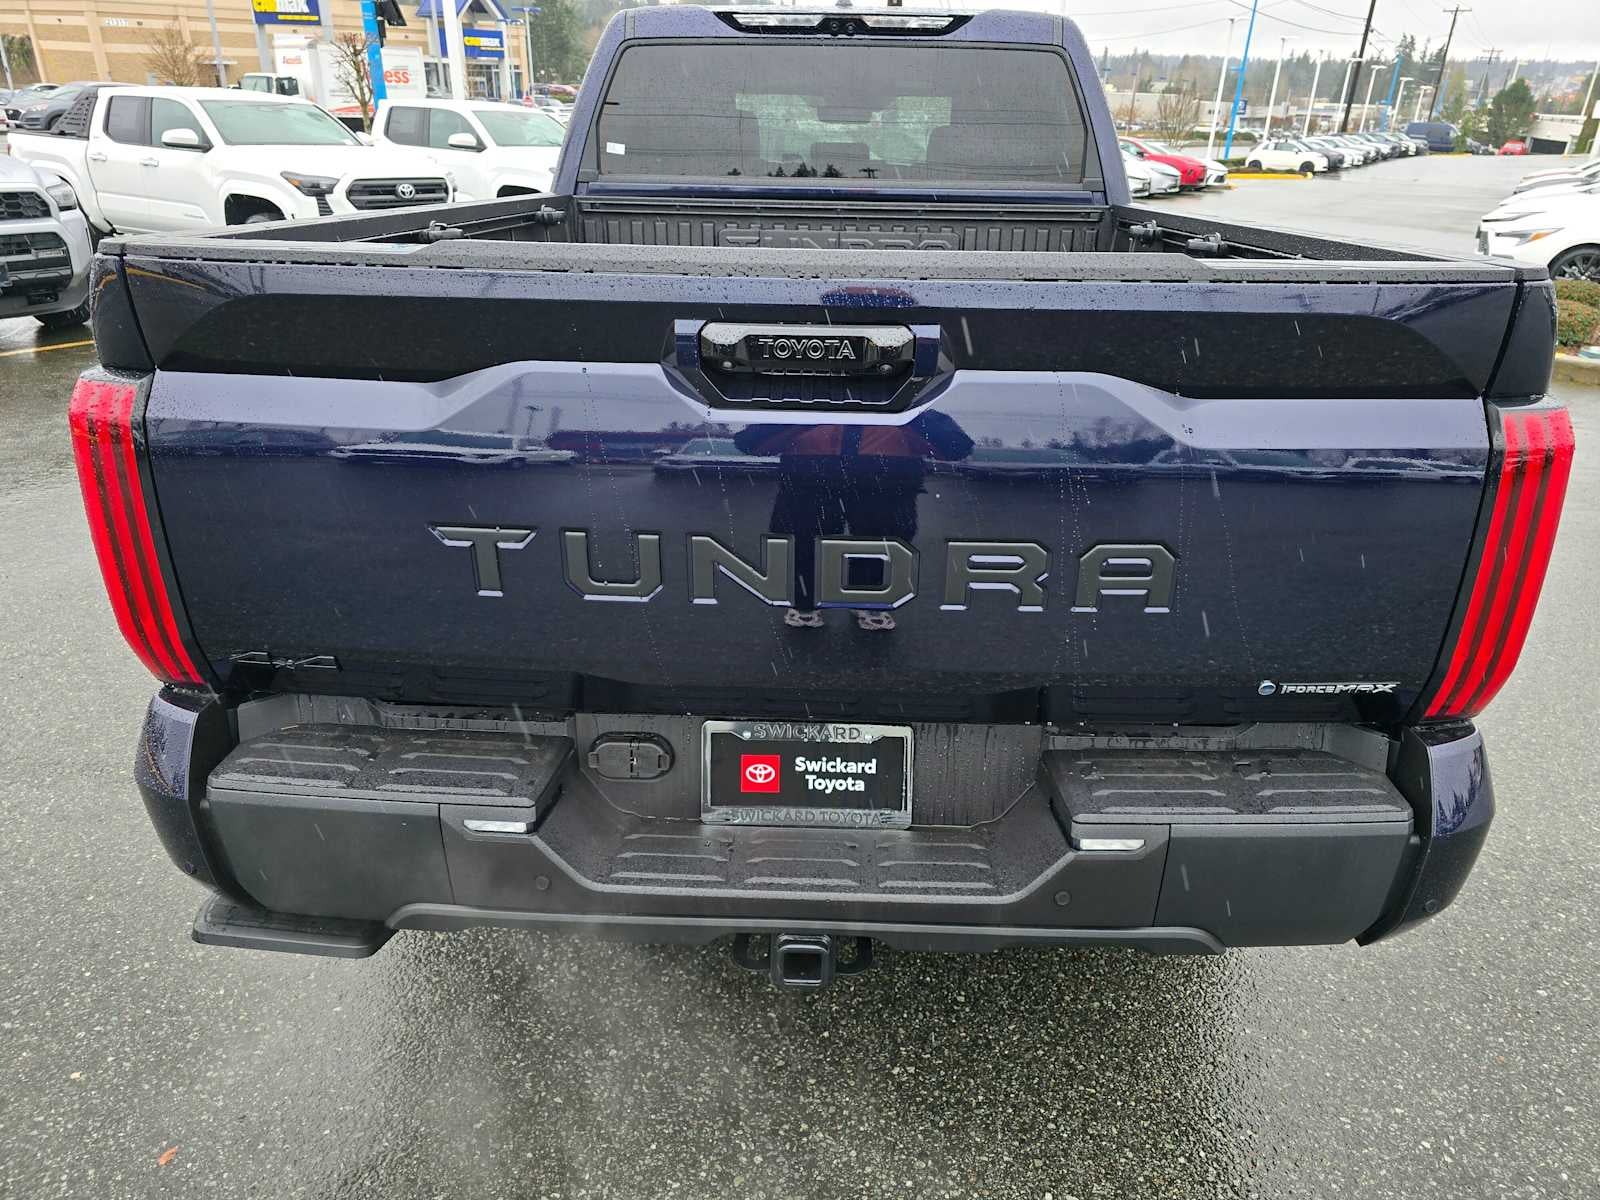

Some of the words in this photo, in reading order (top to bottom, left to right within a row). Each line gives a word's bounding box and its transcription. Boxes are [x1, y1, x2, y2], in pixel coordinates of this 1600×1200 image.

[758, 339, 856, 359] TOYOTA
[427, 524, 1179, 613] TUNDRA
[753, 724, 862, 741] SWICKARD
[794, 757, 877, 774] Swickard
[805, 775, 865, 793] Toyota
[731, 808, 816, 824] SWICKARD
[820, 811, 882, 826] TOYOTA
